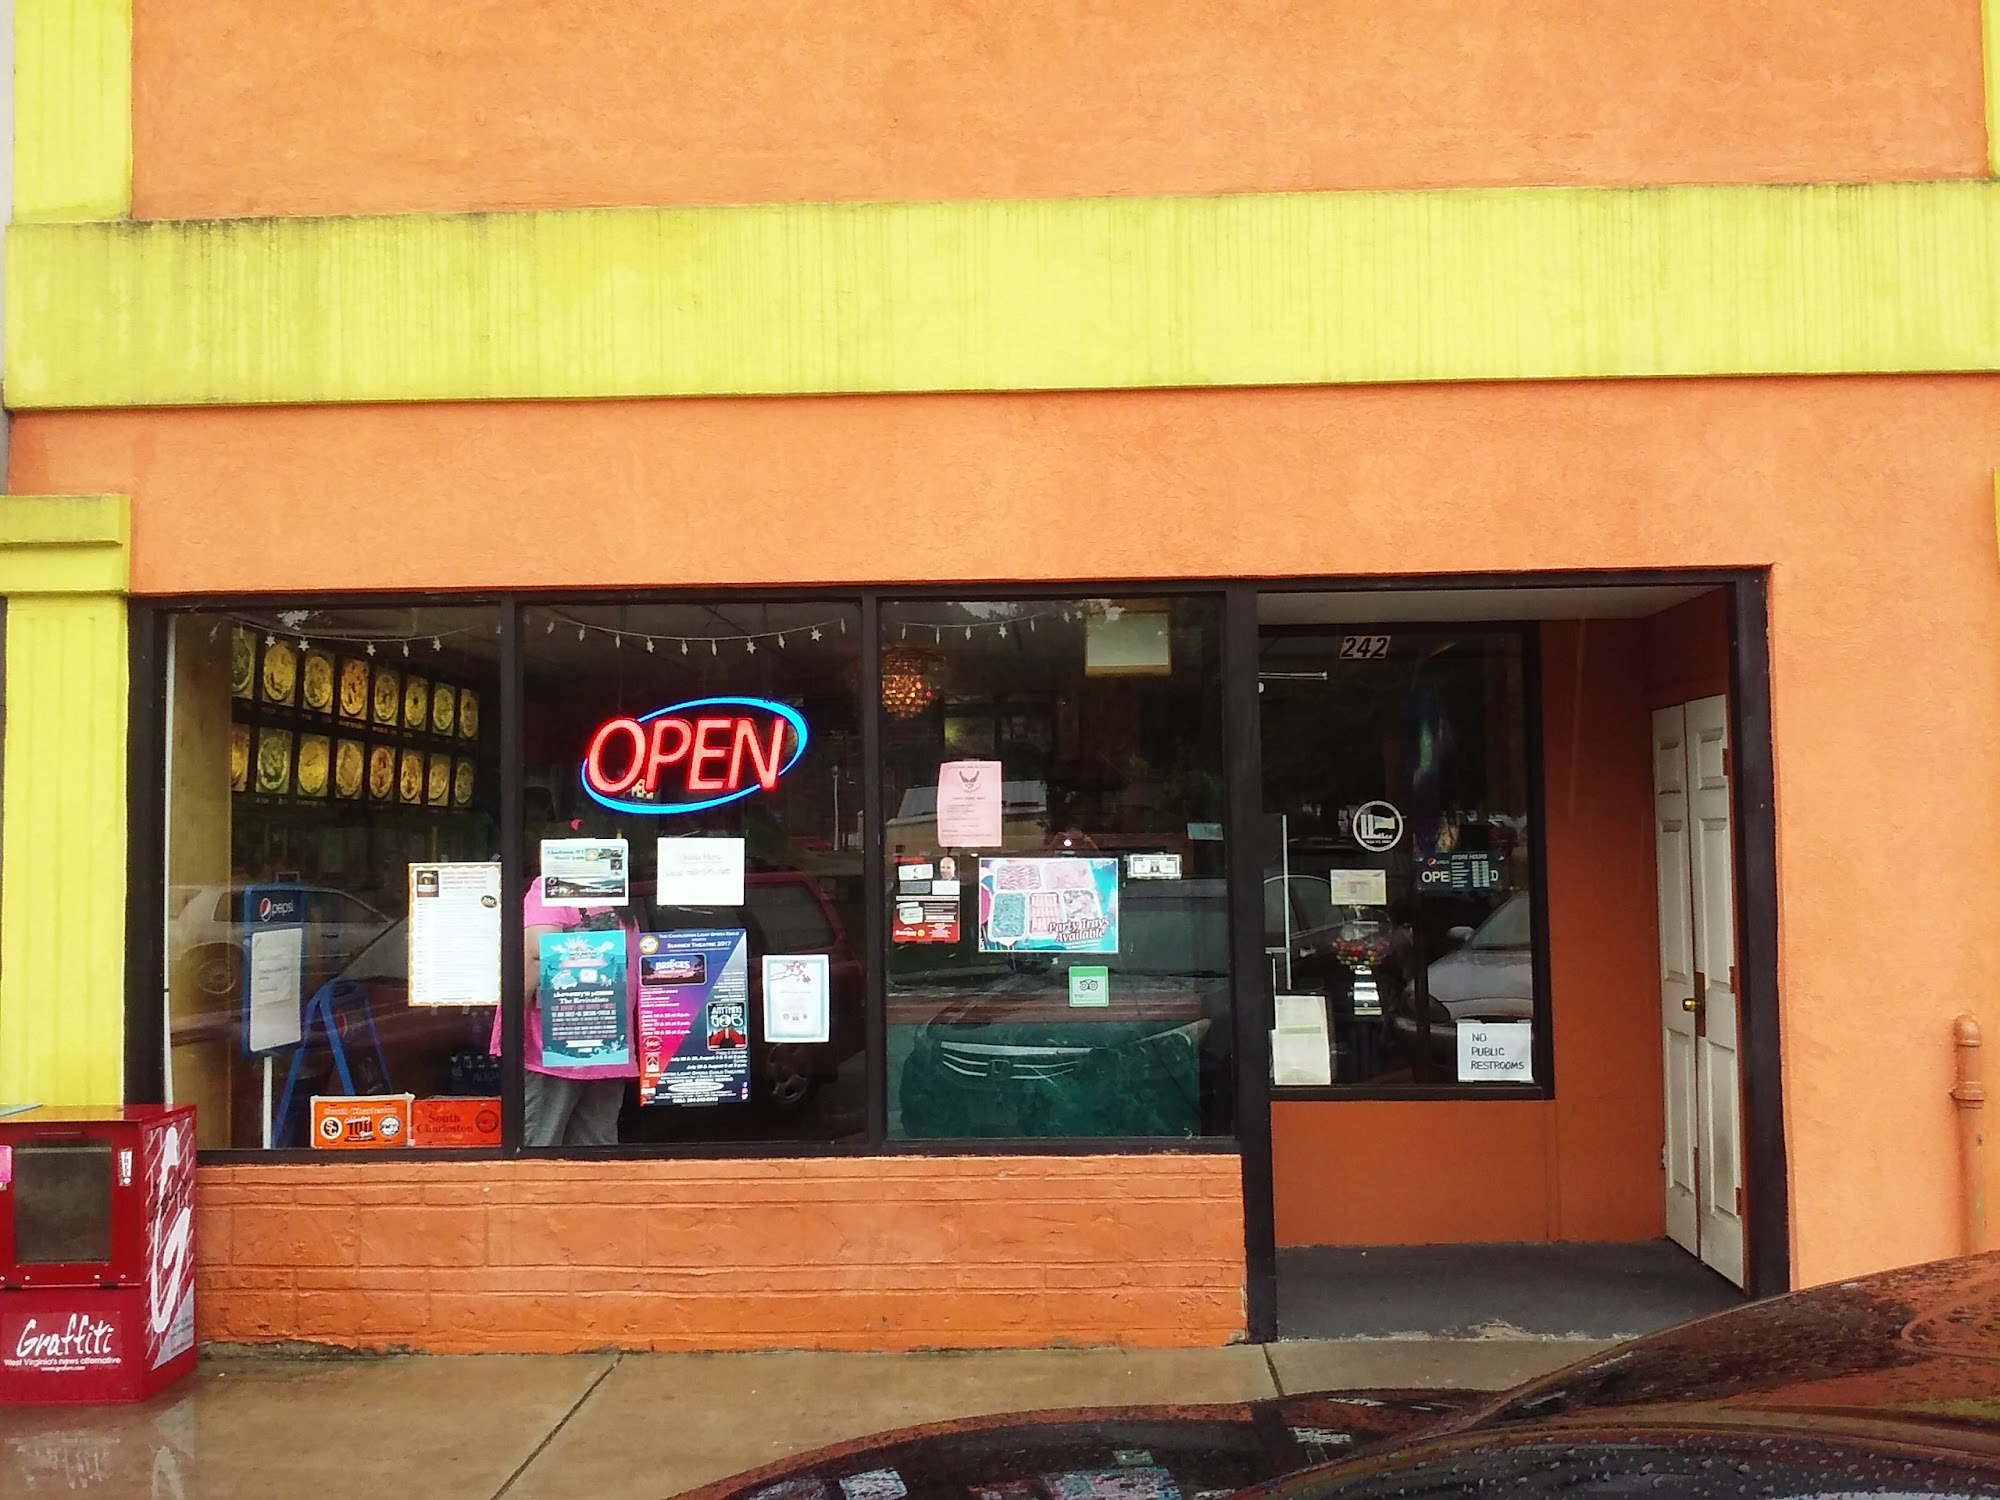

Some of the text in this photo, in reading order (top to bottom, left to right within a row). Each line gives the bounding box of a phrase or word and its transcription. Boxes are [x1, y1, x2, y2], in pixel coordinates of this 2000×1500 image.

[1340, 637, 1388, 658] 242
[586, 716, 788, 794] OPEN
[272, 900, 294, 917] pepsi
[1049, 917, 1110, 933] Party Trays
[1056, 928, 1106, 942] Available
[655, 960, 691, 971] BRIDGES
[1472, 1033, 1487, 1042] NO
[1471, 1046, 1505, 1056] PUBLIC
[1470, 1060, 1525, 1070] RESTROOMS
[324, 1107, 398, 1115] South Charleston
[428, 1113, 461, 1124] South
[416, 1123, 474, 1133] Charleston
[16, 1313, 115, 1357] Graffiti
[4, 1358, 21, 1366] West
[24, 1357, 58, 1367] Virginia's
[80, 1357, 121, 1365] alternative
